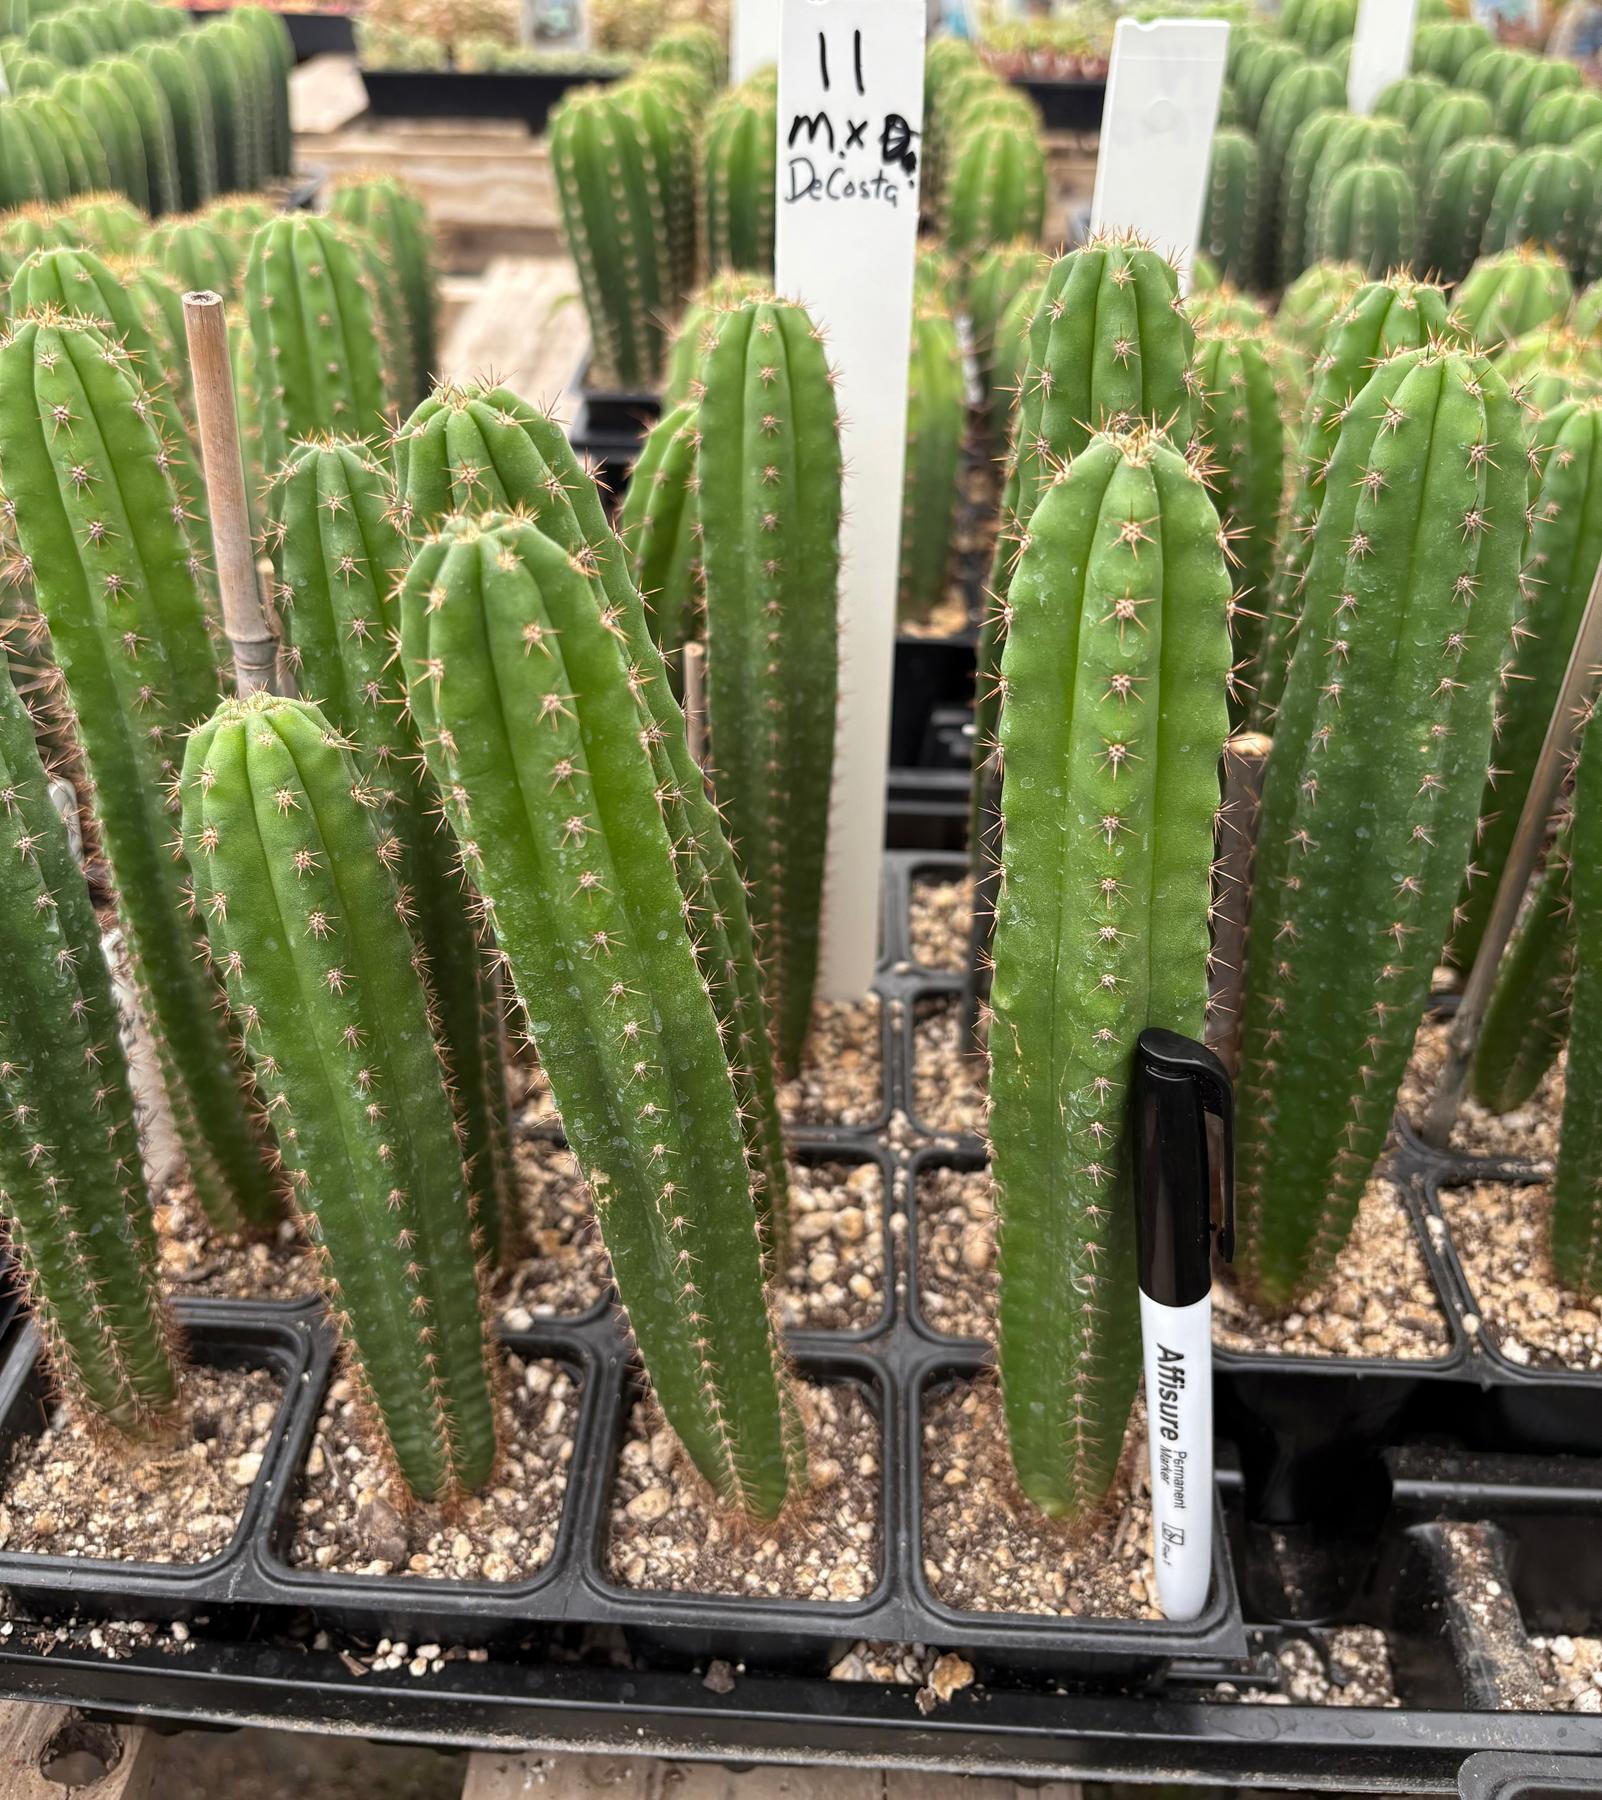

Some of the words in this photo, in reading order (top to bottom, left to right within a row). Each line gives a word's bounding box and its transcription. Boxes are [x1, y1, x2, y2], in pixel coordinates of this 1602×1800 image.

[817, 28, 865, 97] 11
[785, 157, 898, 208] DeCosta
[1156, 1342, 1185, 1442] Affisure
[1159, 1444, 1172, 1486] Marker
[1172, 1450, 1187, 1510] Permanent
